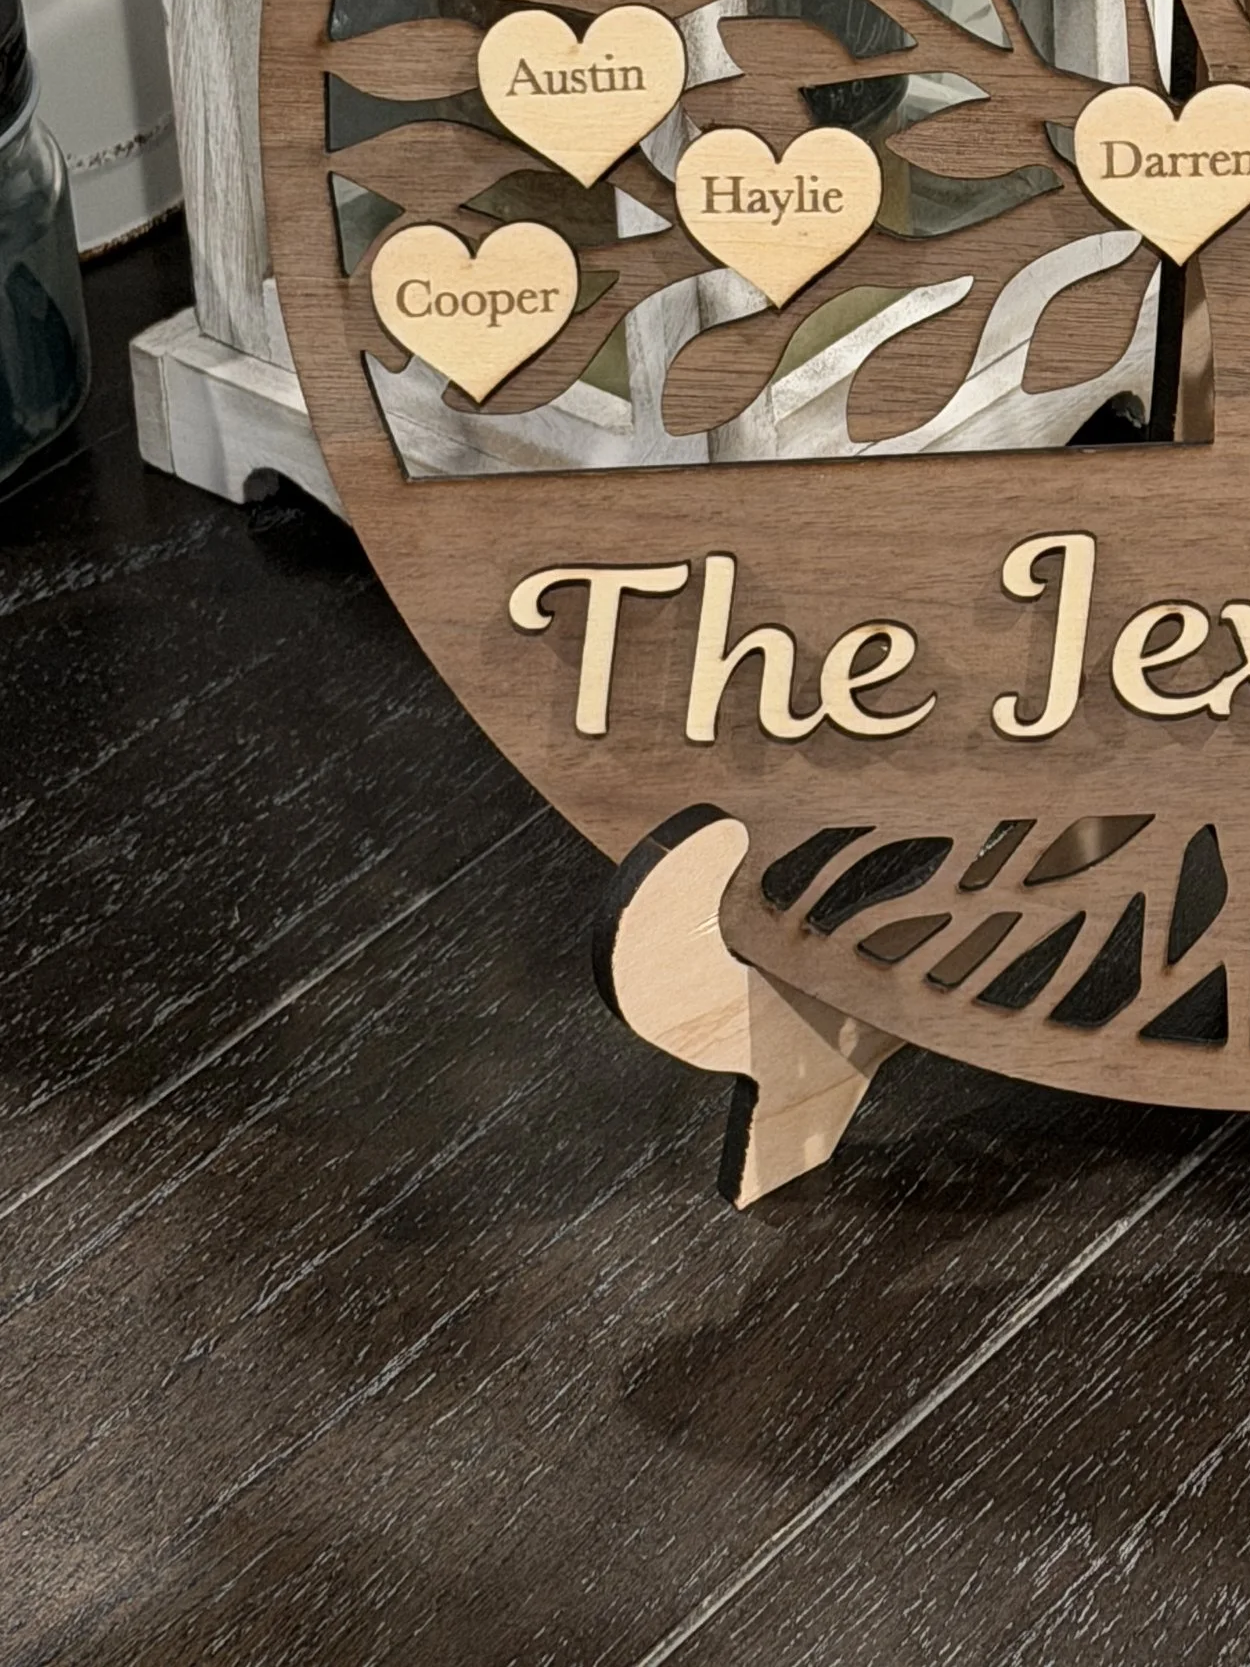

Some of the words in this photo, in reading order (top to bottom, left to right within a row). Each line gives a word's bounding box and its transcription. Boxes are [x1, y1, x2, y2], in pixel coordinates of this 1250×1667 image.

[506, 53, 646, 97] Austin
[702, 175, 844, 227] Haylie
[396, 280, 560, 328] Cooper
[508, 550, 938, 746] The
